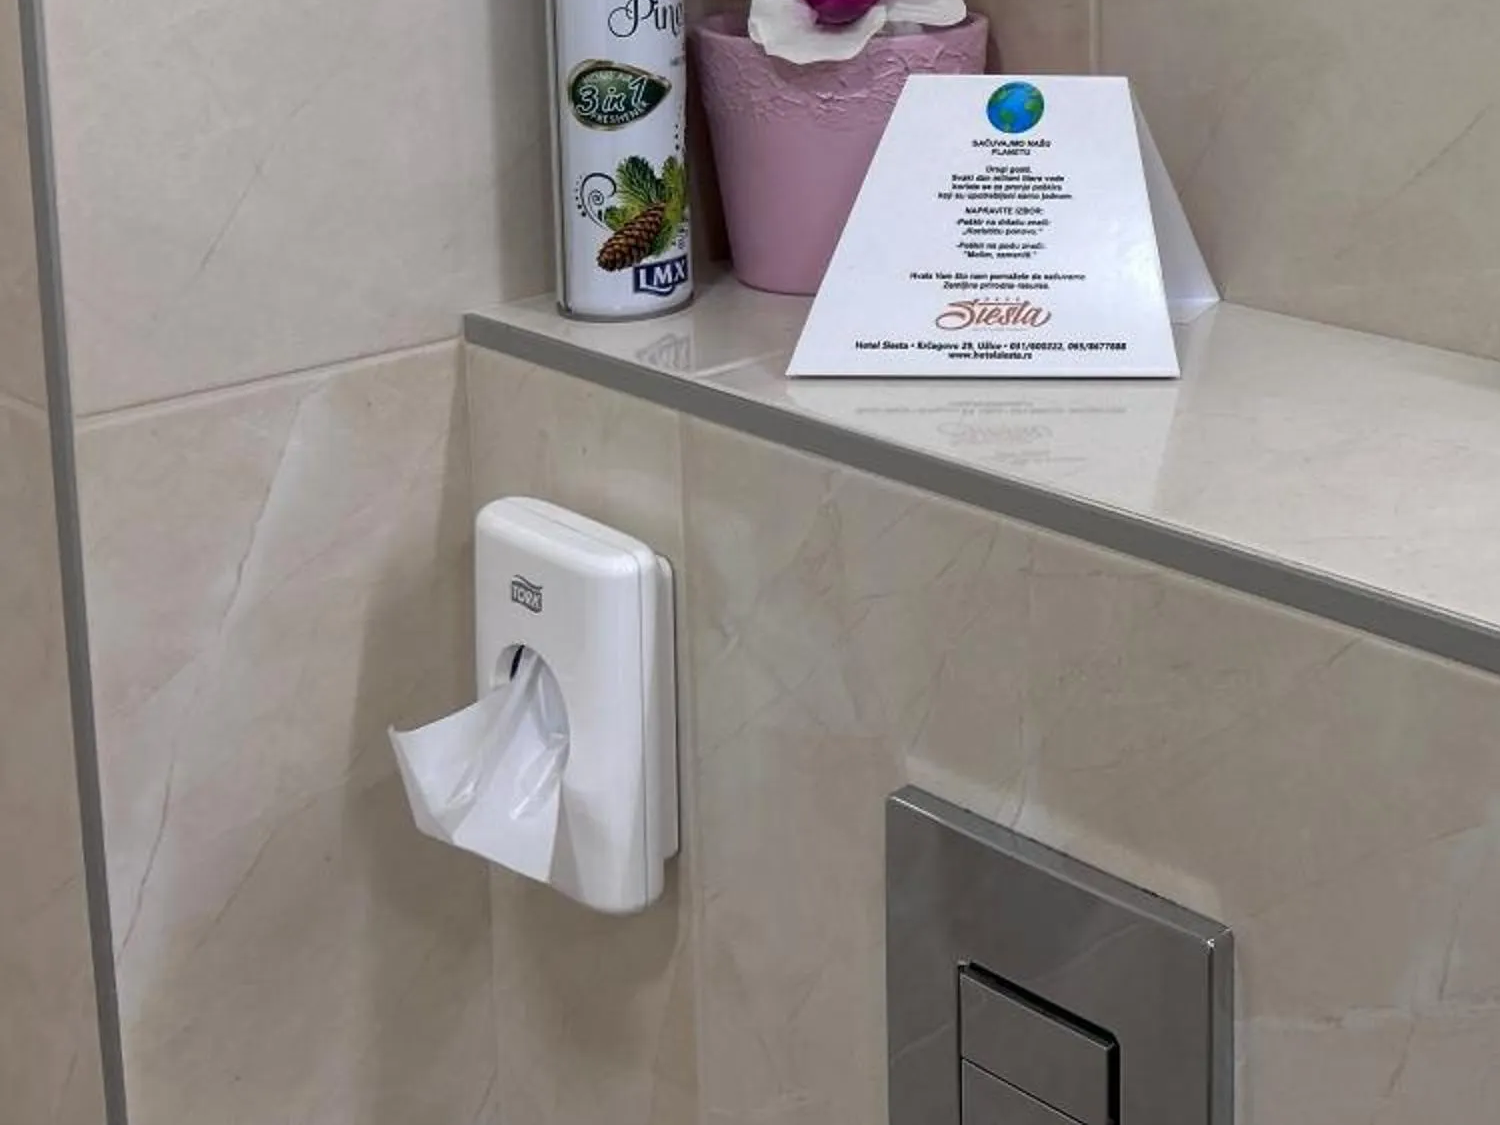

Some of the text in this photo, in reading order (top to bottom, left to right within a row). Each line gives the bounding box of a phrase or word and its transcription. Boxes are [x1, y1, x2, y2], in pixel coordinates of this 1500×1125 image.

[576, 75, 649, 116] 3 in 1
[639, 259, 686, 289] LMX
[935, 298, 1052, 331] Siesta
[855, 341, 880, 350] Hotel
[882, 341, 909, 350] Siesta
[512, 585, 542, 610] TORK
